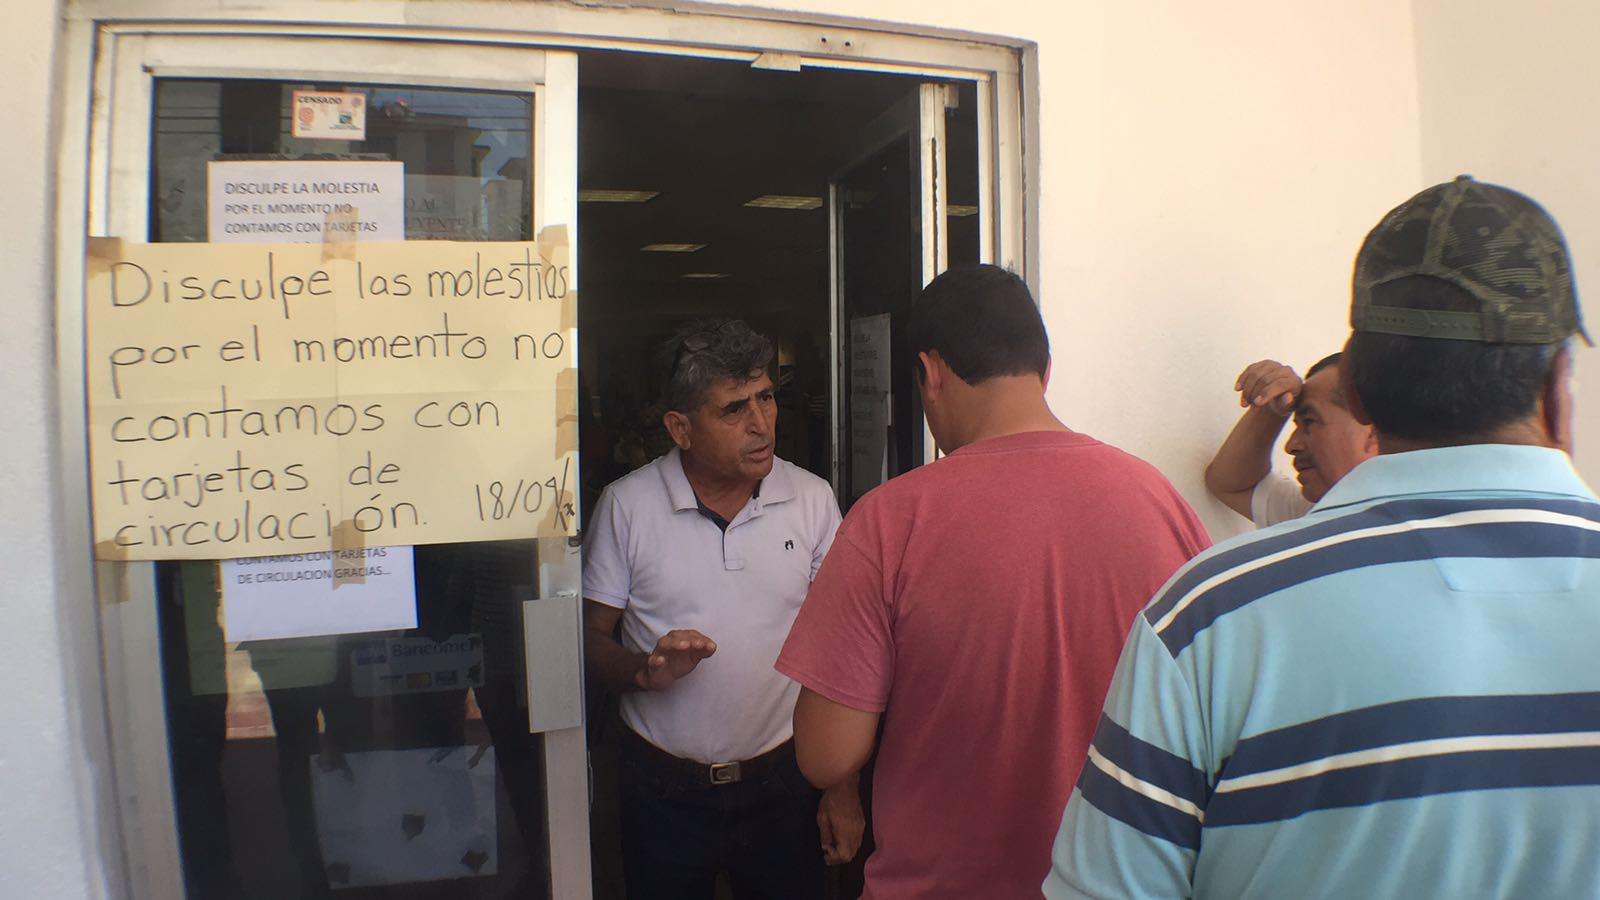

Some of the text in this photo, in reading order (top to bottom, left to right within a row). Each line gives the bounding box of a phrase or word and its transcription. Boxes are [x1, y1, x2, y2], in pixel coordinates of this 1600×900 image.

[224, 182, 380, 194] DISCULPE LA MOLESTIA
[225, 203, 352, 214] POR EL MOMENTO NO
[224, 221, 378, 234] CONTAMOS CON TARJETAS
[110, 247, 568, 320] Disculpe las molestias
[109, 312, 564, 399] por el momento no
[111, 385, 499, 442] contamos con
[107, 450, 401, 508] tarjetas de
[306, 552, 331, 562] CON
[334, 547, 387, 559] TARJETAS
[238, 574, 252, 584] DE
[256, 569, 332, 583] CIRCULACION
